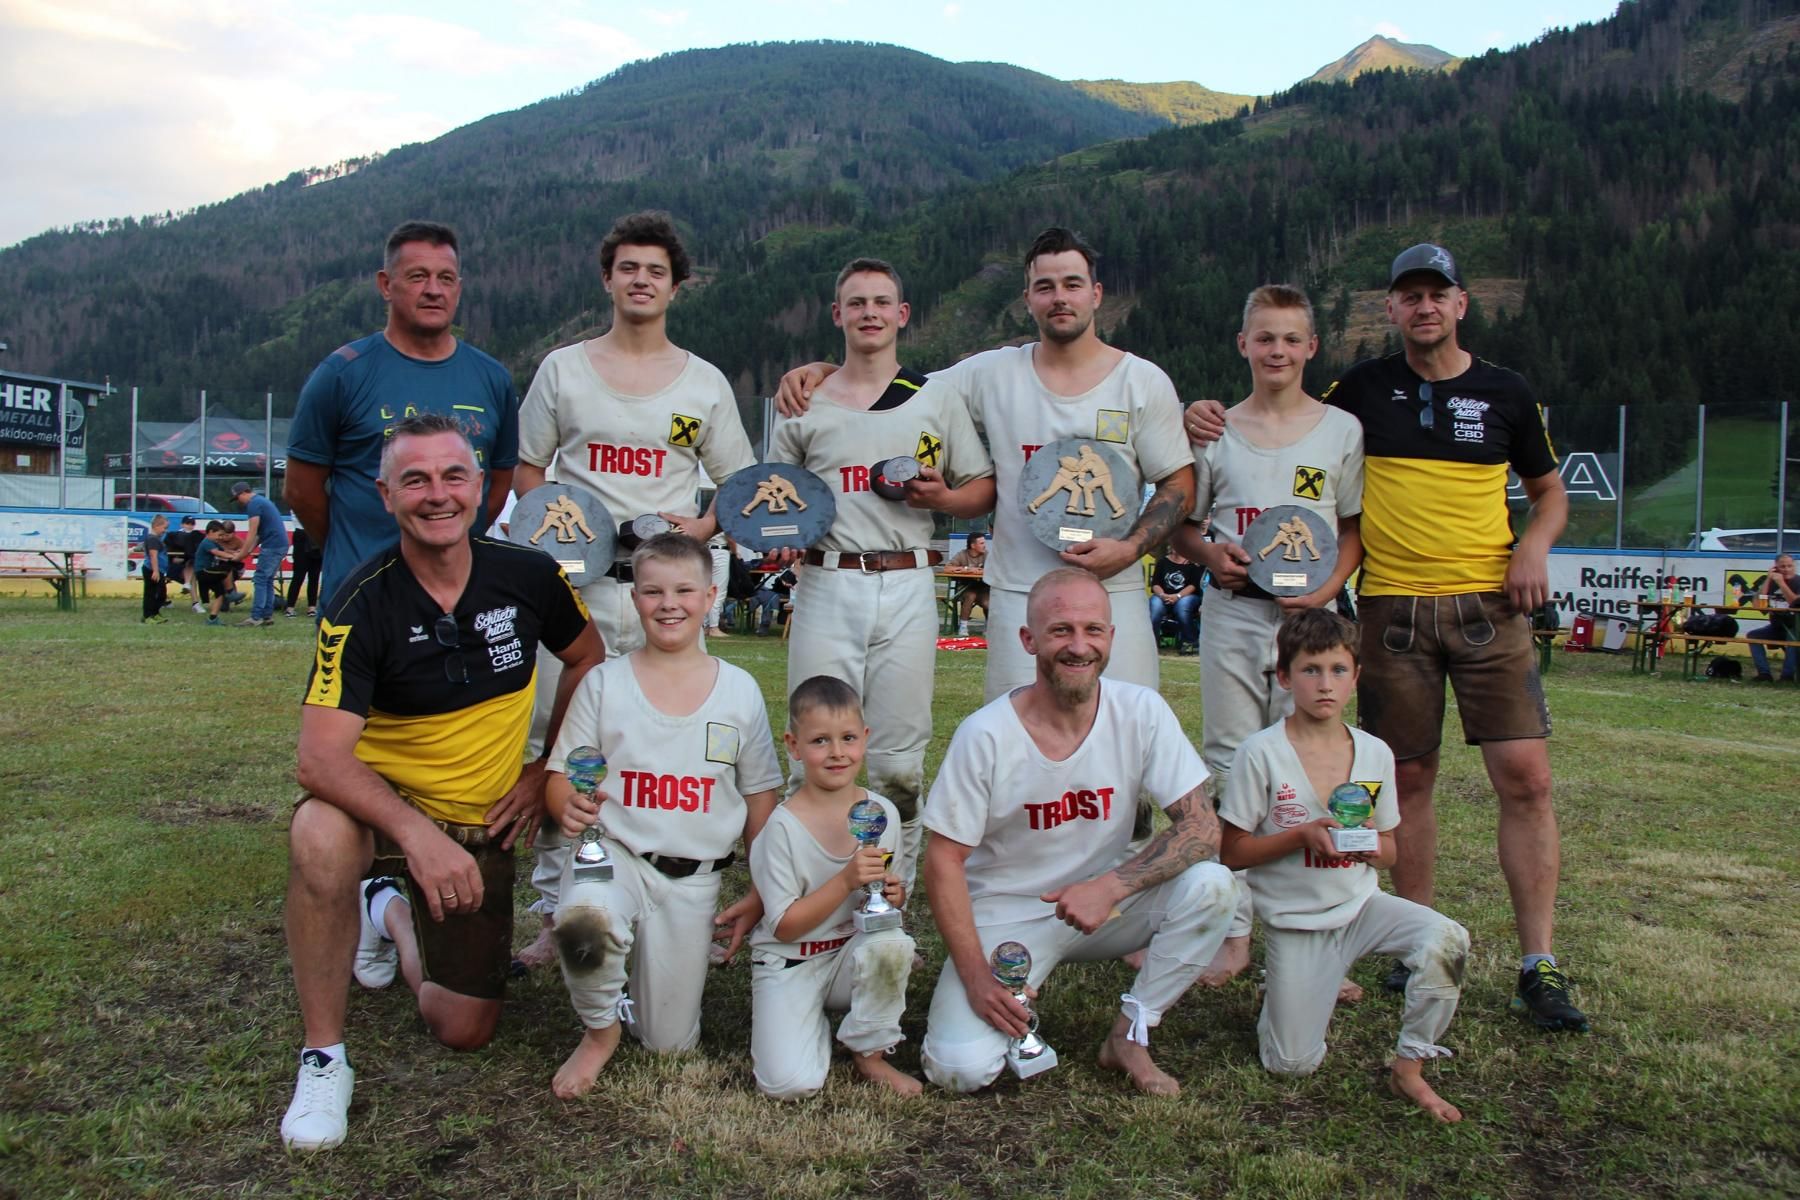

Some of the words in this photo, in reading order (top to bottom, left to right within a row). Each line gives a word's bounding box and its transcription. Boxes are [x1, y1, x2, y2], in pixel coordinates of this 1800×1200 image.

[1453, 422, 1484, 431] Hanfi
[1454, 430, 1484, 439] CBD
[587, 443, 667, 478] TROST
[488, 638, 522, 657] Hanfi
[492, 649, 522, 667] CBD
[620, 770, 716, 814] TROST
[1024, 787, 1115, 831] TROST
